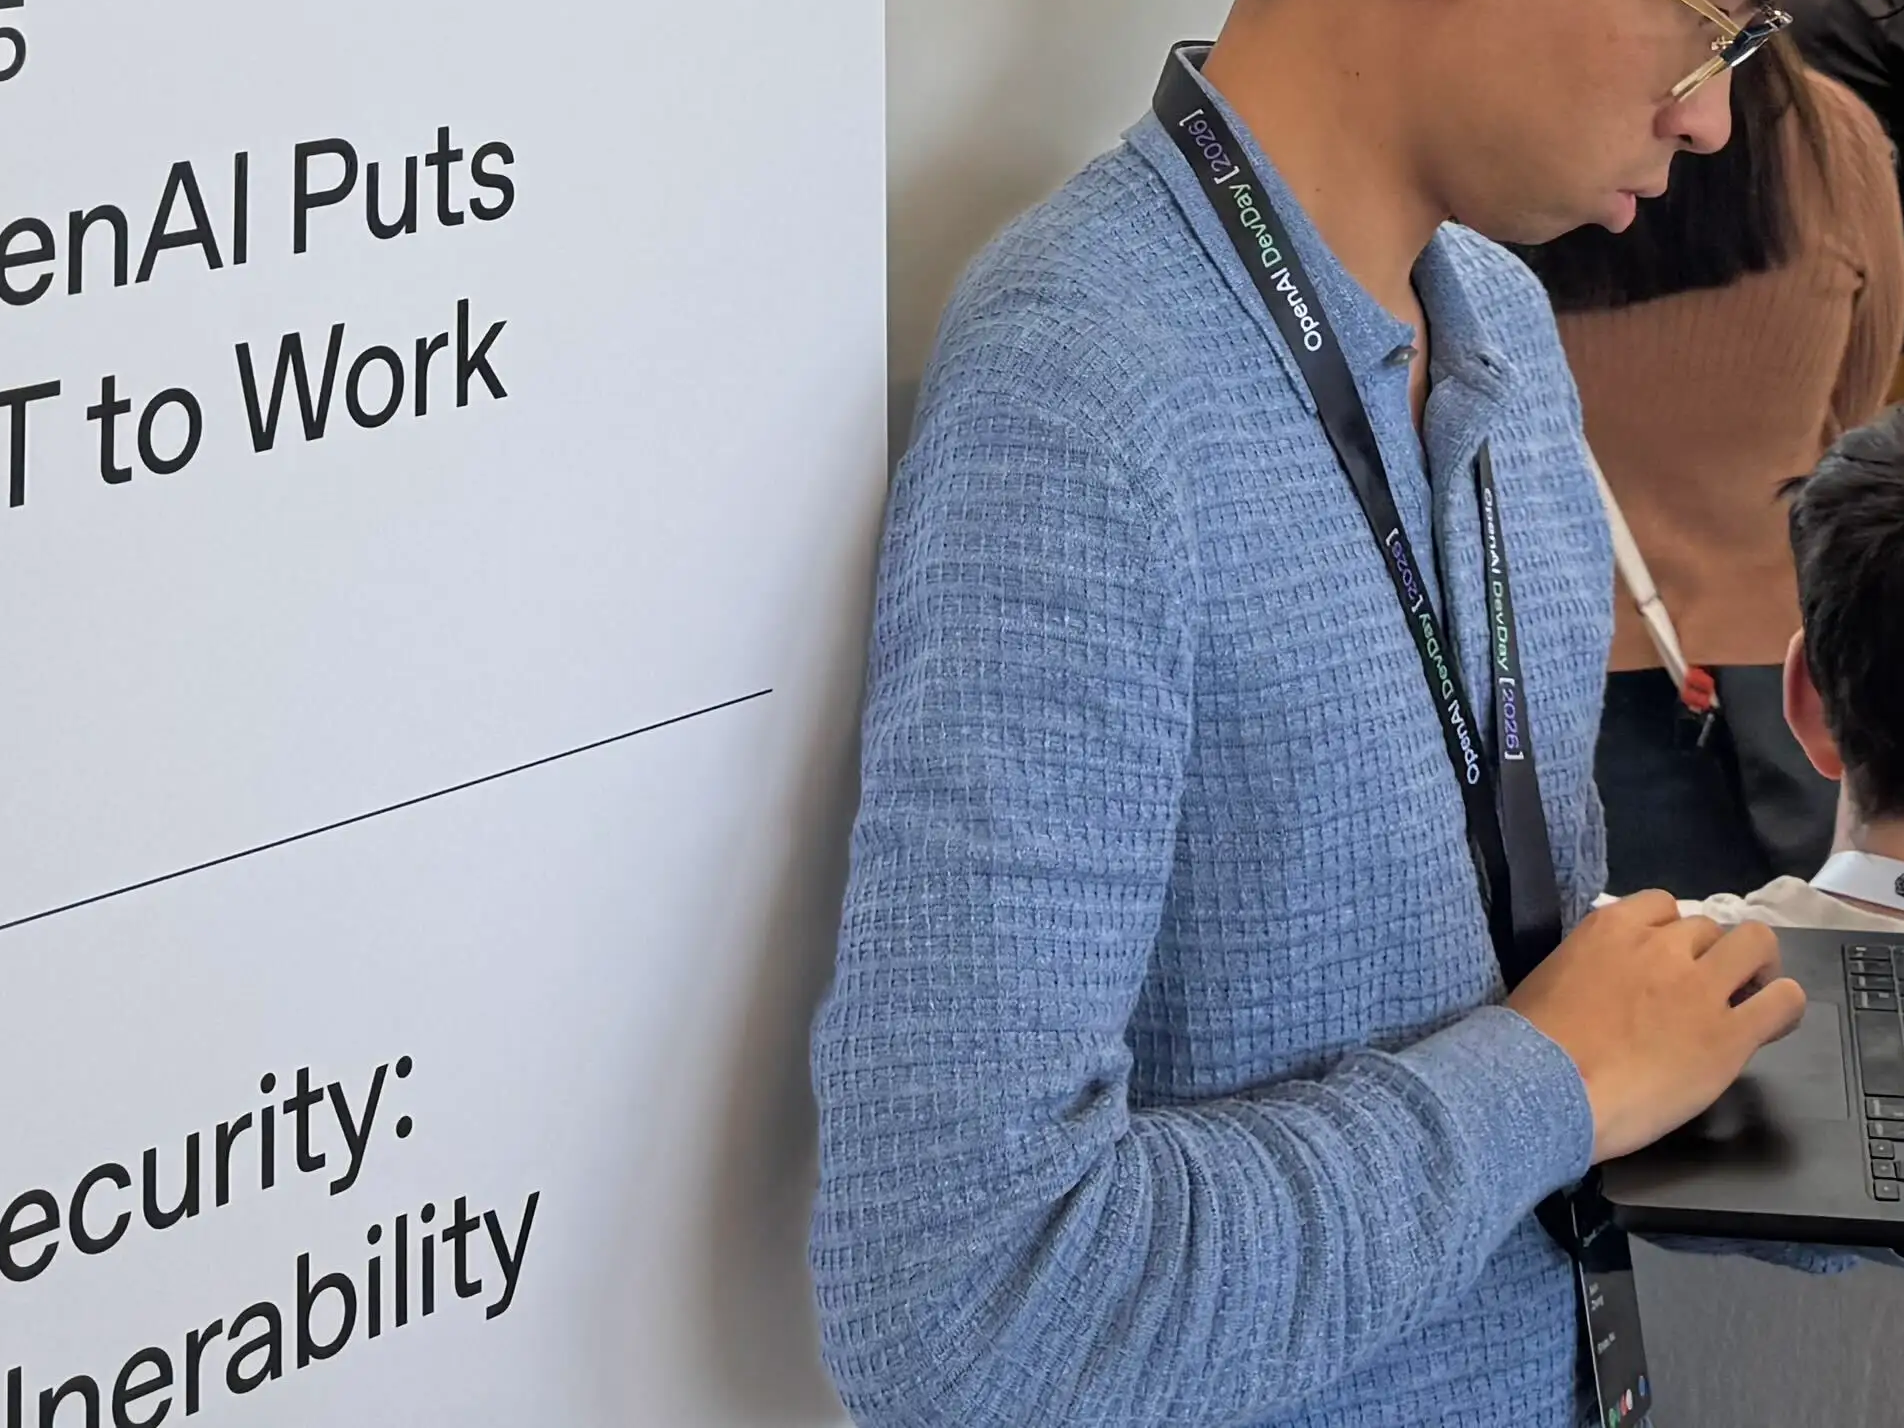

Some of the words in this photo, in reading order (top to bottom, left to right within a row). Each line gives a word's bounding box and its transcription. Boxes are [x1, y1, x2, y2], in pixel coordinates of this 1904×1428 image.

[1178, 108, 1241, 185] [2026]
[292, 124, 516, 256] Puts
[1228, 182, 1283, 268] DevDay
[1270, 266, 1323, 352] OpenAI
[85, 373, 204, 486] to
[233, 297, 509, 455] Work
[1418, 612, 1454, 700] DevDay
[1492, 581, 1510, 672] DevDay
[1448, 699, 1480, 785] OpenAI
[1498, 676, 1525, 761] [2026]
